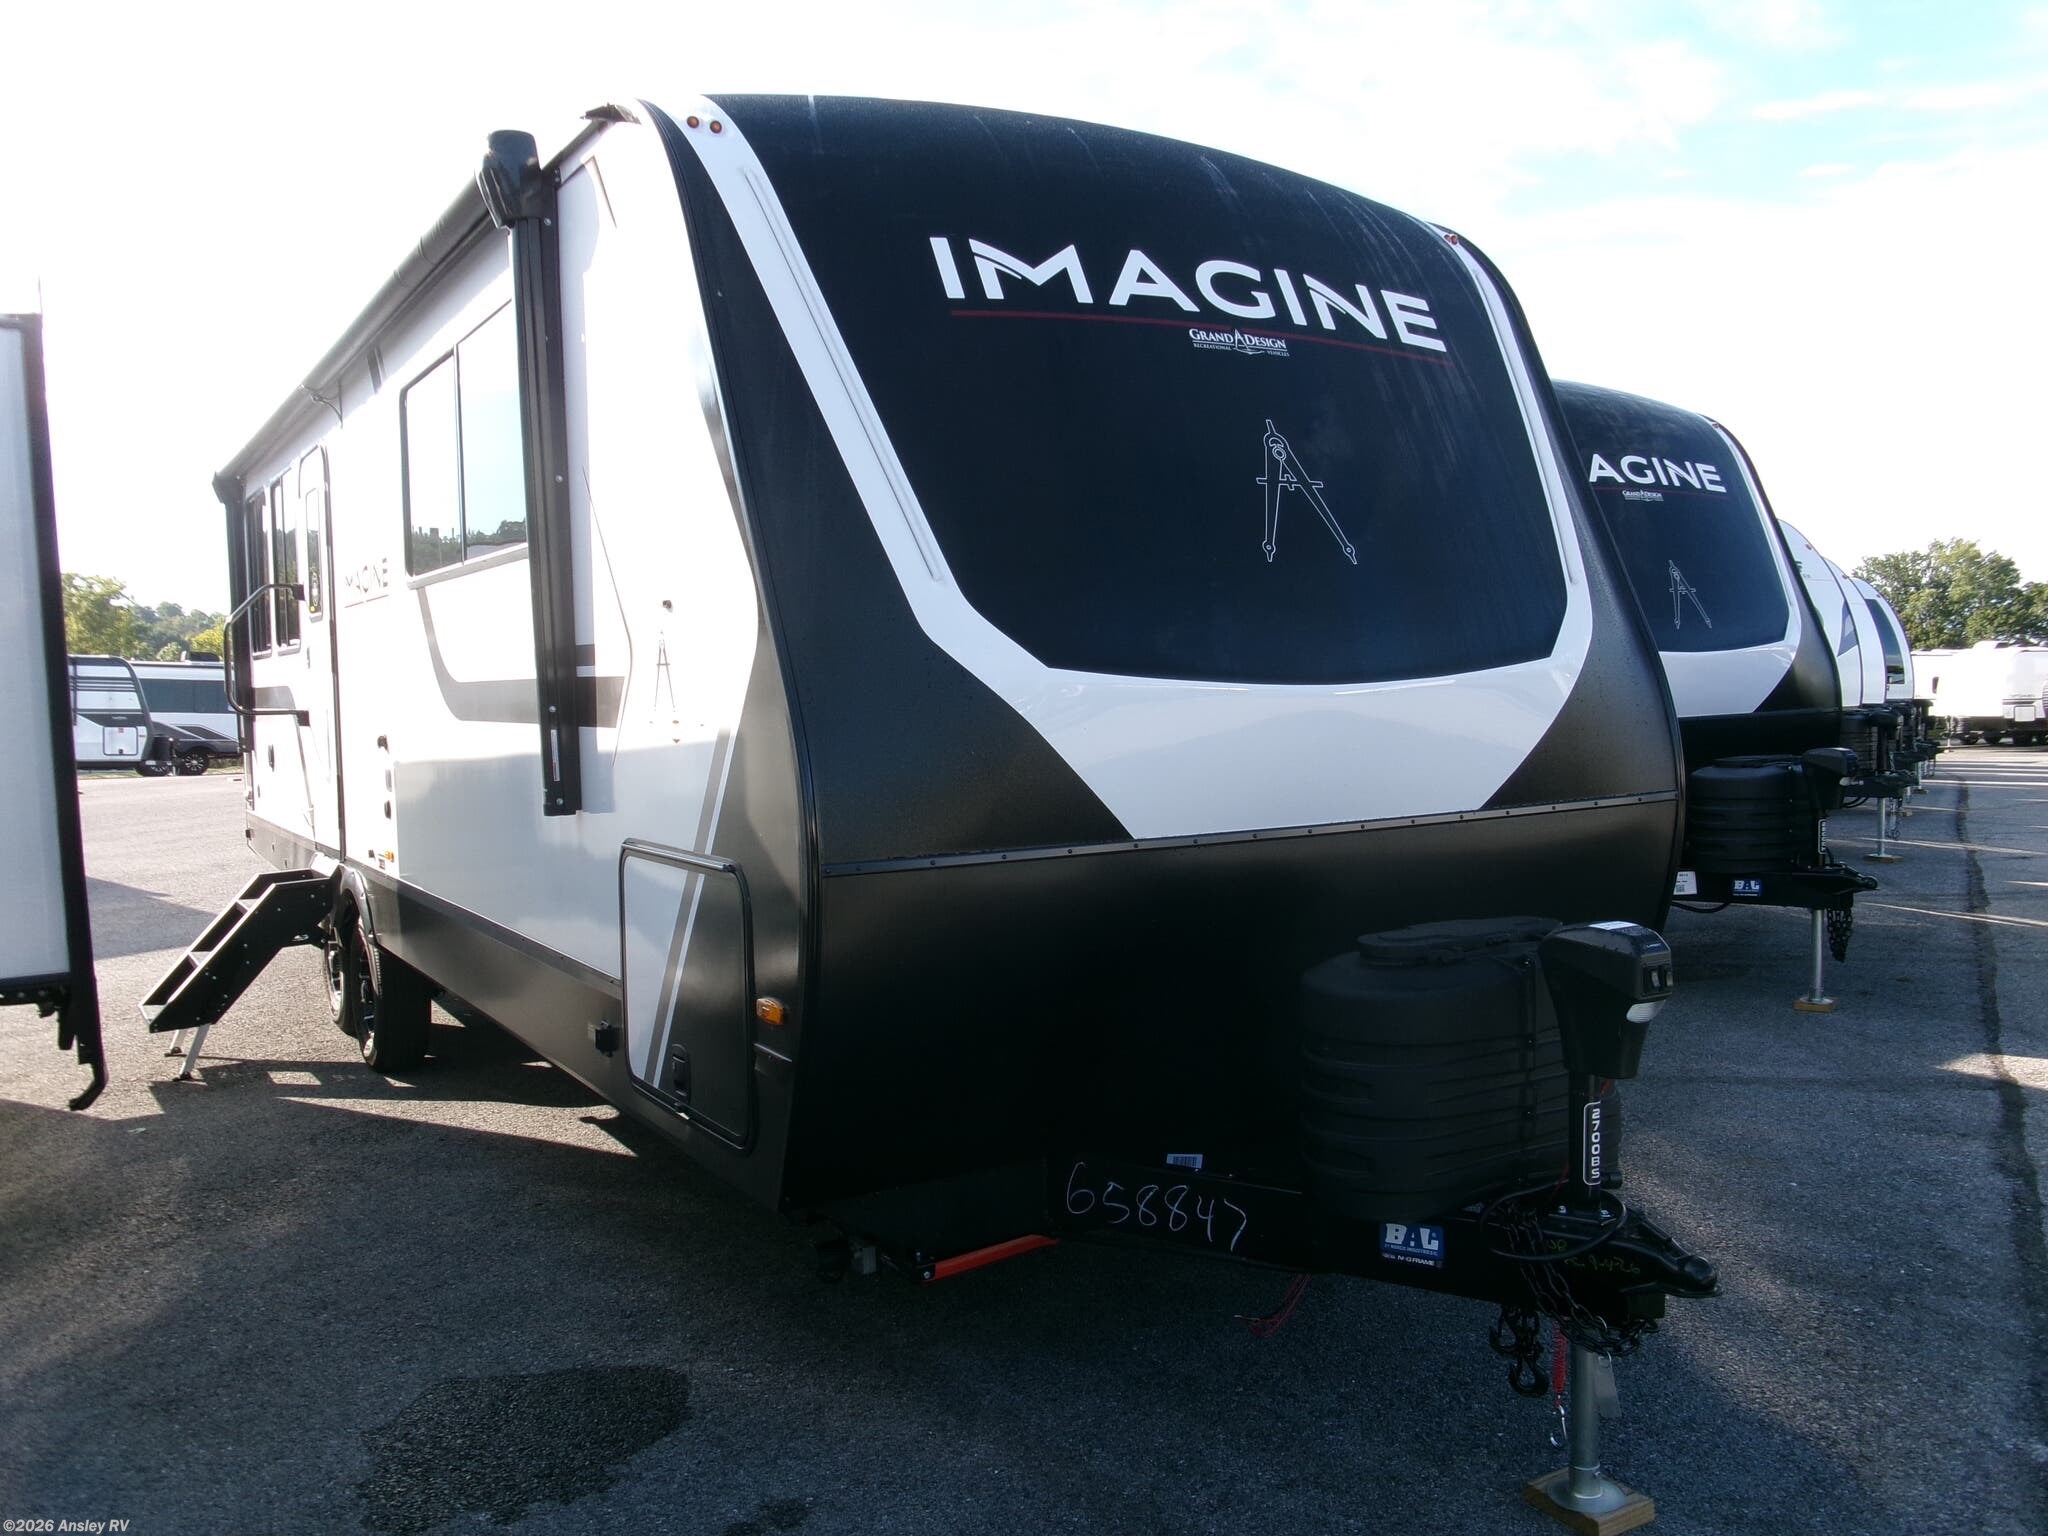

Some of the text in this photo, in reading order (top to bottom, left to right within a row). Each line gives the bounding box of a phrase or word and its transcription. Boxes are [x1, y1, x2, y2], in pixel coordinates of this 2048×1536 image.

[929, 236, 1448, 353] IMAGINE
[1189, 328, 1287, 349] GRAND DESIGN
[1591, 1108, 1601, 1179] 2700BS
[1066, 1161, 1247, 1252] 658847
